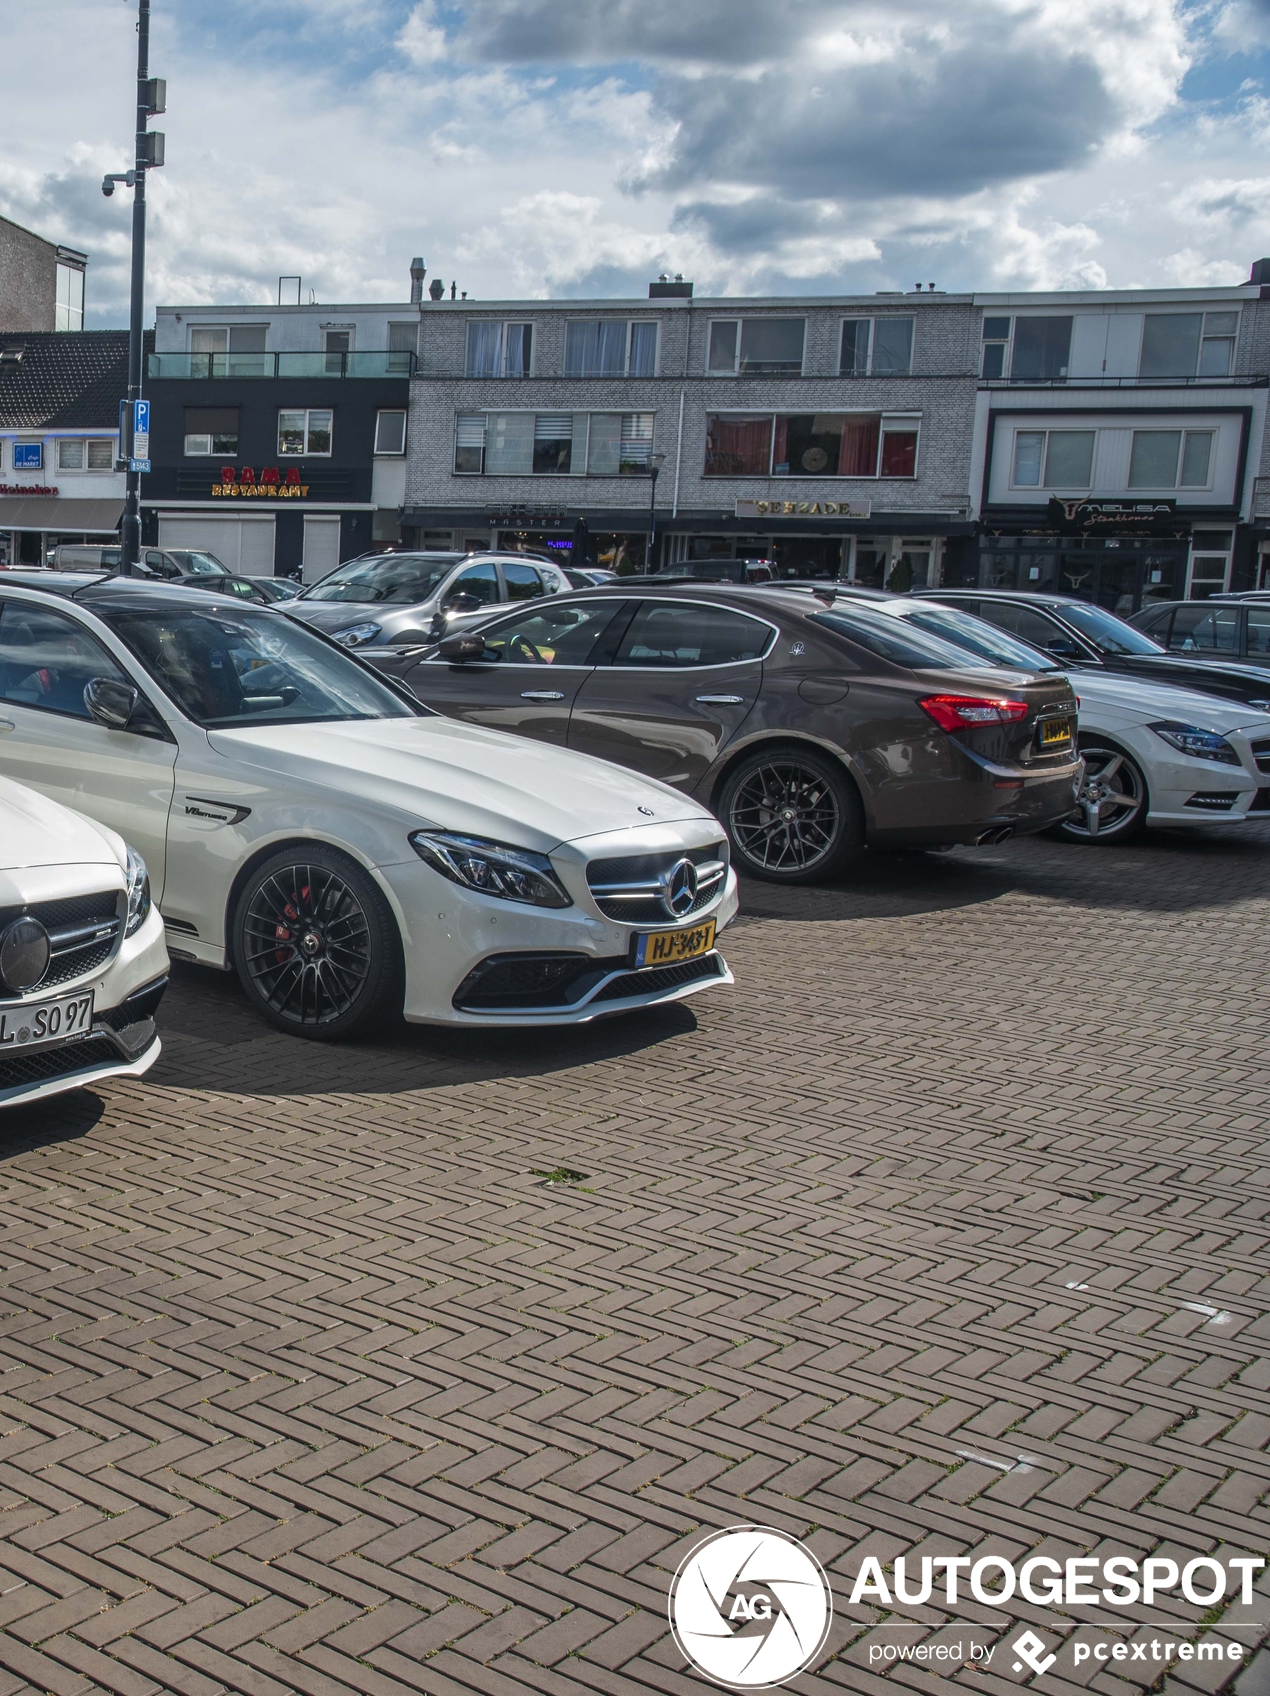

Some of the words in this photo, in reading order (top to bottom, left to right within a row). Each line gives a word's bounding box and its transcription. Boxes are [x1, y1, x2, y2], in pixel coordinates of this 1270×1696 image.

[138, 403, 147, 420] P
[136, 461, 150, 471] 5143
[221, 466, 302, 485] RAMA
[211, 484, 310, 497] RESTAURANT
[484, 504, 568, 516] SHISHA
[490, 519, 561, 527] MASTER
[1084, 513, 1155, 526] Steakhouse
[653, 926, 712, 960] HJ-343-T
[32, 1005, 62, 1038] SO
[65, 996, 91, 1032] 97
